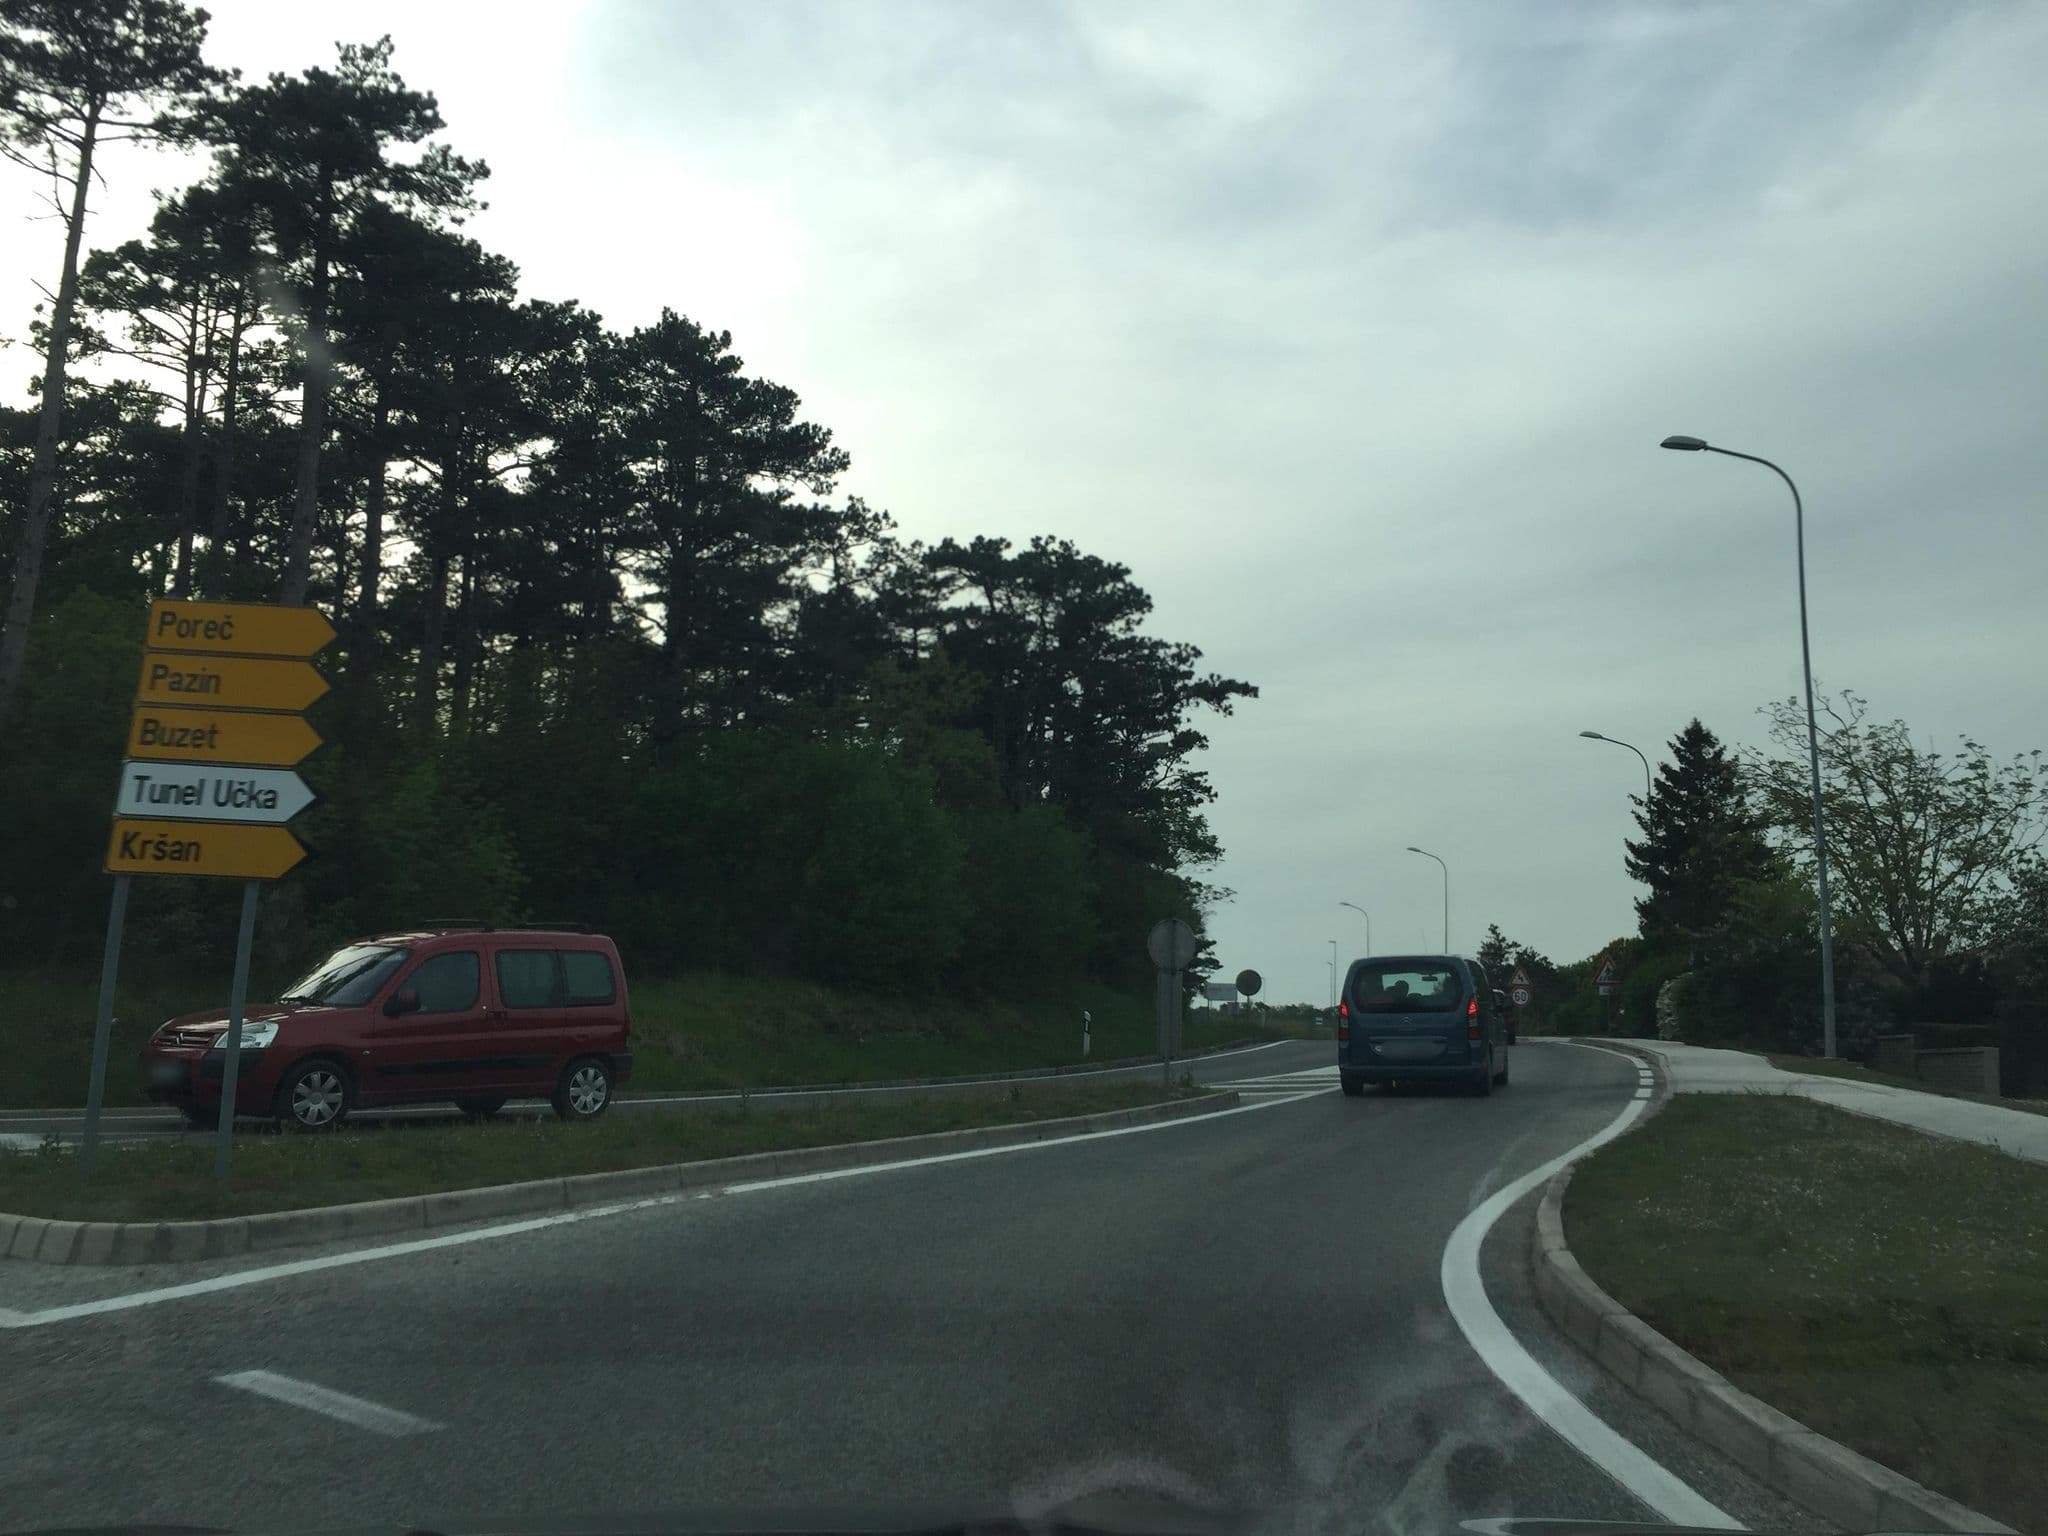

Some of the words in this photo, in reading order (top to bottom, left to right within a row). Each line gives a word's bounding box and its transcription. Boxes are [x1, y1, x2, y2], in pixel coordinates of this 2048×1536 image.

[156, 611, 234, 641] Poreč
[149, 664, 221, 694] Pazin
[139, 718, 220, 748] Buzet
[133, 775, 205, 805] Tunel
[212, 779, 279, 810] Učka
[118, 831, 202, 862] Kršan
